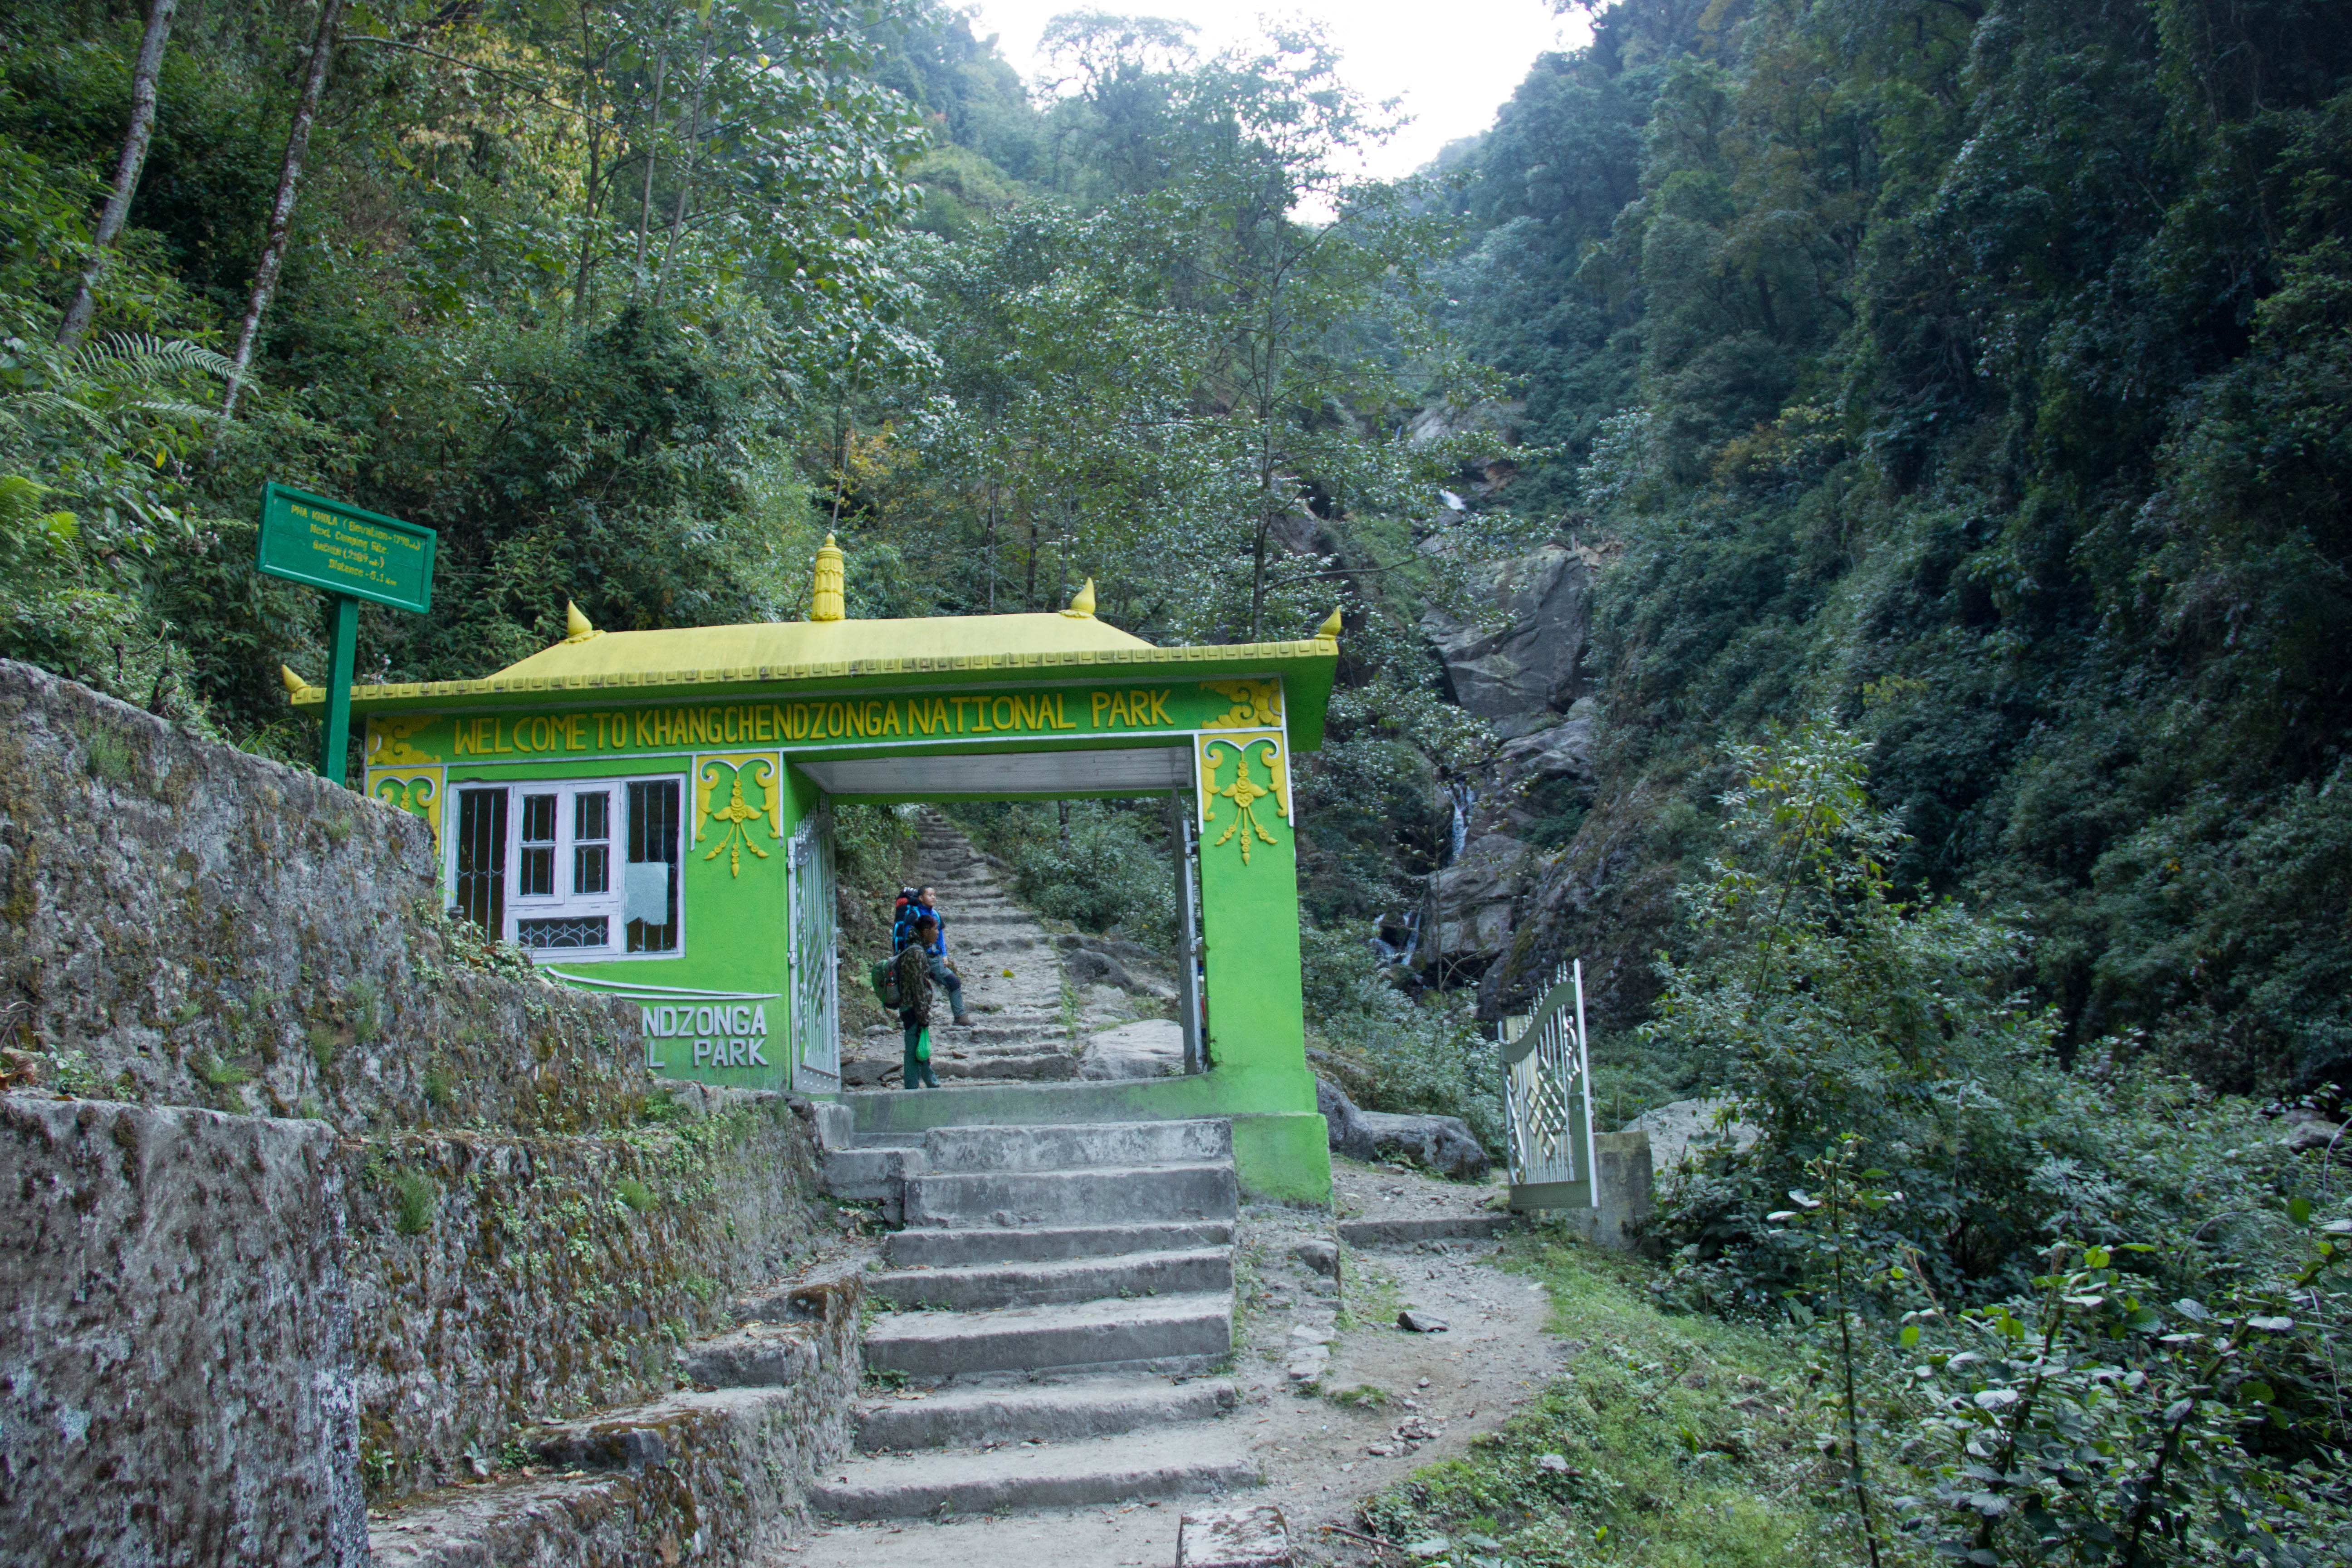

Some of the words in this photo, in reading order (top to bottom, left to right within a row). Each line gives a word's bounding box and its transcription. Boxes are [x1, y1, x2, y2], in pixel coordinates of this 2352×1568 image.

[291, 504, 307, 518] PHA
[312, 510, 337, 526] KHOLA
[310, 524, 331, 538] Next
[335, 531, 368, 550] Camping
[328, 559, 363, 577] Distance
[454, 716, 587, 755] WELCOME
[593, 712, 628, 750] TO
[635, 701, 900, 748] KHANGCHENDZONGA
[908, 694, 1077, 735] NATIONAL
[1091, 689, 1175, 728] PARK
[642, 1004, 767, 1038] NDZONGA
[693, 1038, 769, 1068] PARK
